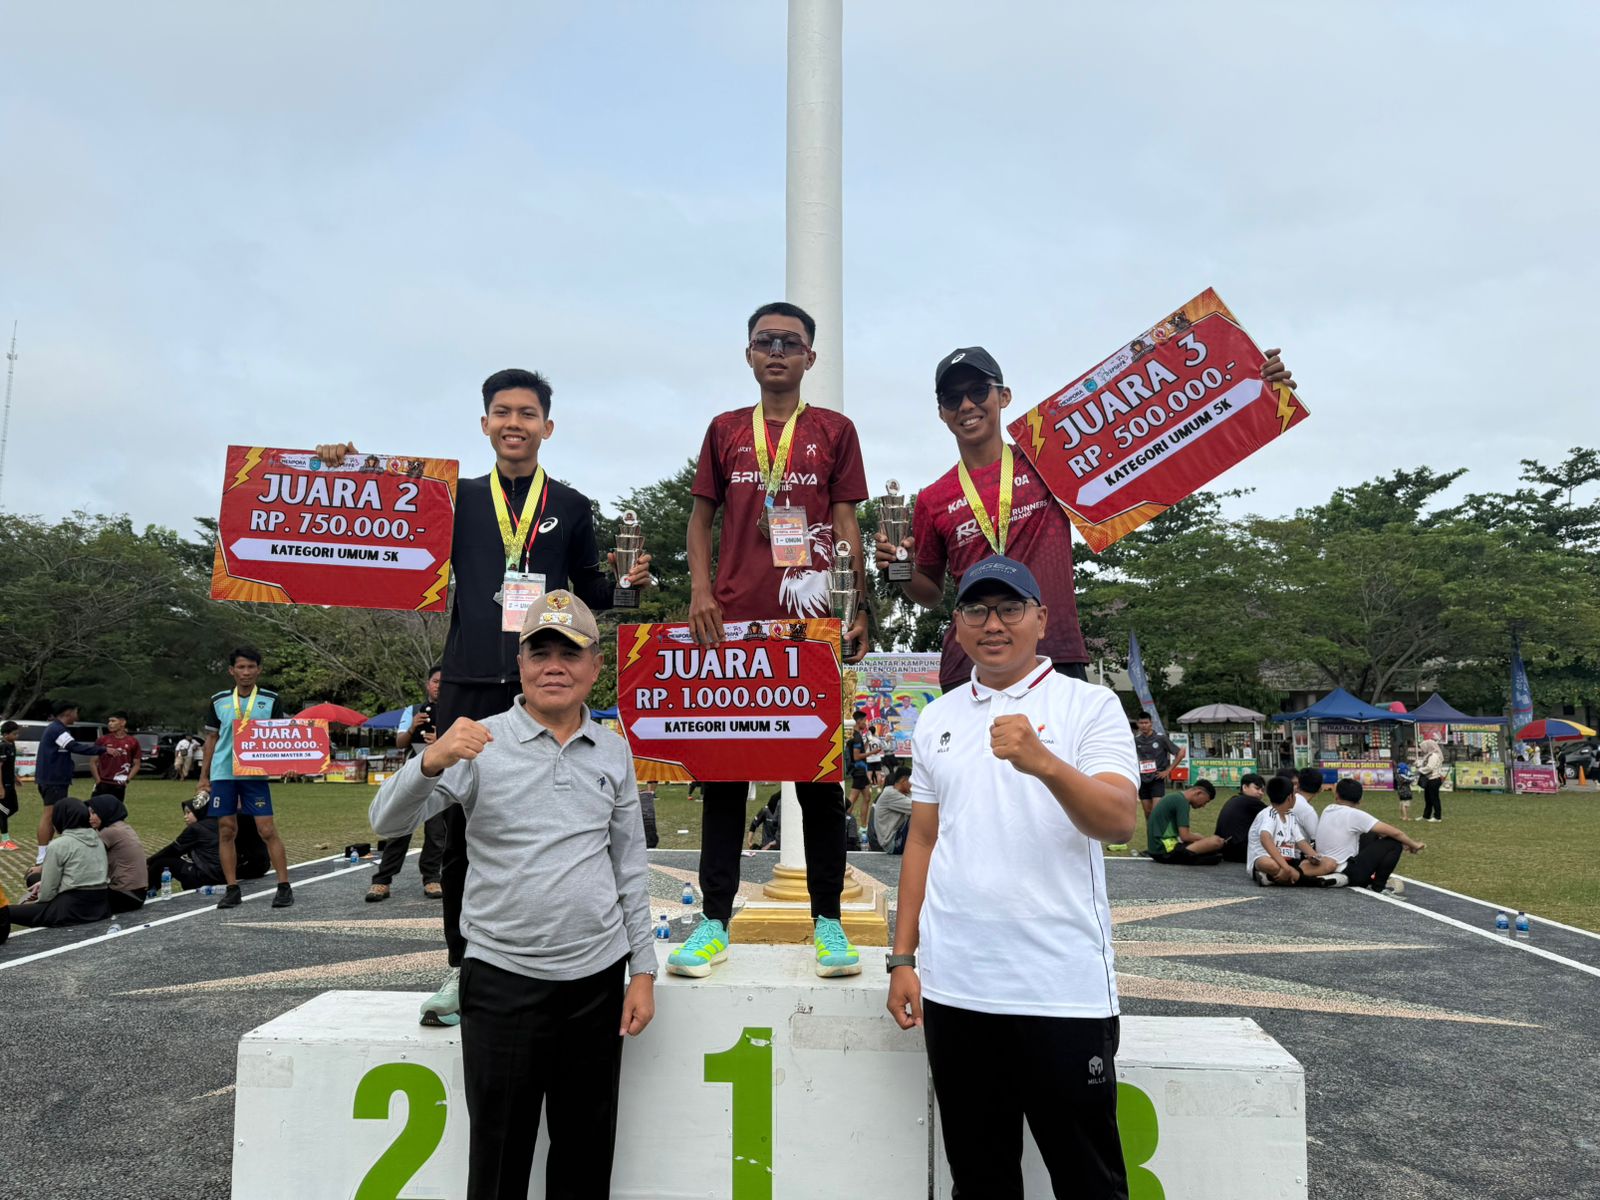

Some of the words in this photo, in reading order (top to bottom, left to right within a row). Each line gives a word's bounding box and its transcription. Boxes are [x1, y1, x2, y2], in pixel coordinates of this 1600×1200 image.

[1054, 359, 1179, 451] JUARA
[1177, 332, 1208, 368] 3
[1104, 441, 1169, 487] KATEGORI
[1169, 412, 1213, 446] UMUM
[1215, 398, 1233, 418] 5K
[1067, 443, 1114, 479] RP.
[257, 473, 383, 511] JUARA
[393, 481, 420, 513] 2
[1012, 499, 1048, 516] RUNNERS
[250, 508, 291, 533] RP.
[271, 543, 335, 559] KATEGORI
[337, 548, 379, 561] UMUM
[382, 551, 399, 562] 5K
[654, 647, 774, 680] JUARA
[784, 646, 800, 678] 1
[635, 687, 674, 710] RP.
[250, 728, 301, 739] JUARA
[306, 728, 312, 738] 1
[665, 721, 726, 733] KATEGORI
[730, 720, 771, 732] UMUM
[774, 720, 791, 731] 5K
[212, 797, 221, 808] 6
[704, 1027, 772, 1200] 1
[353, 1063, 447, 1200] 2
